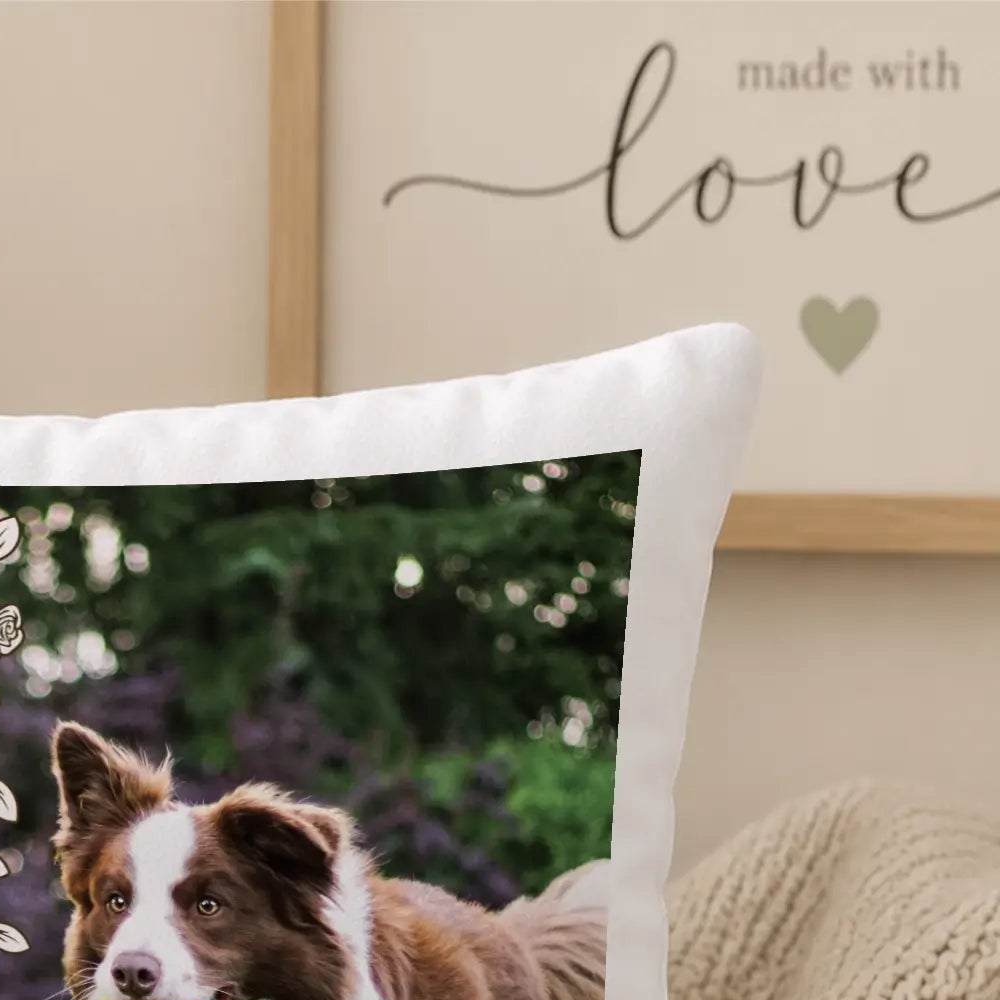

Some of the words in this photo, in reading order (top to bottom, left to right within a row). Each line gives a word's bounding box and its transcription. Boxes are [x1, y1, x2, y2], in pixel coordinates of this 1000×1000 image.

[737, 46, 852, 91] made
[867, 46, 961, 91] with
[383, 39, 1000, 241] love
